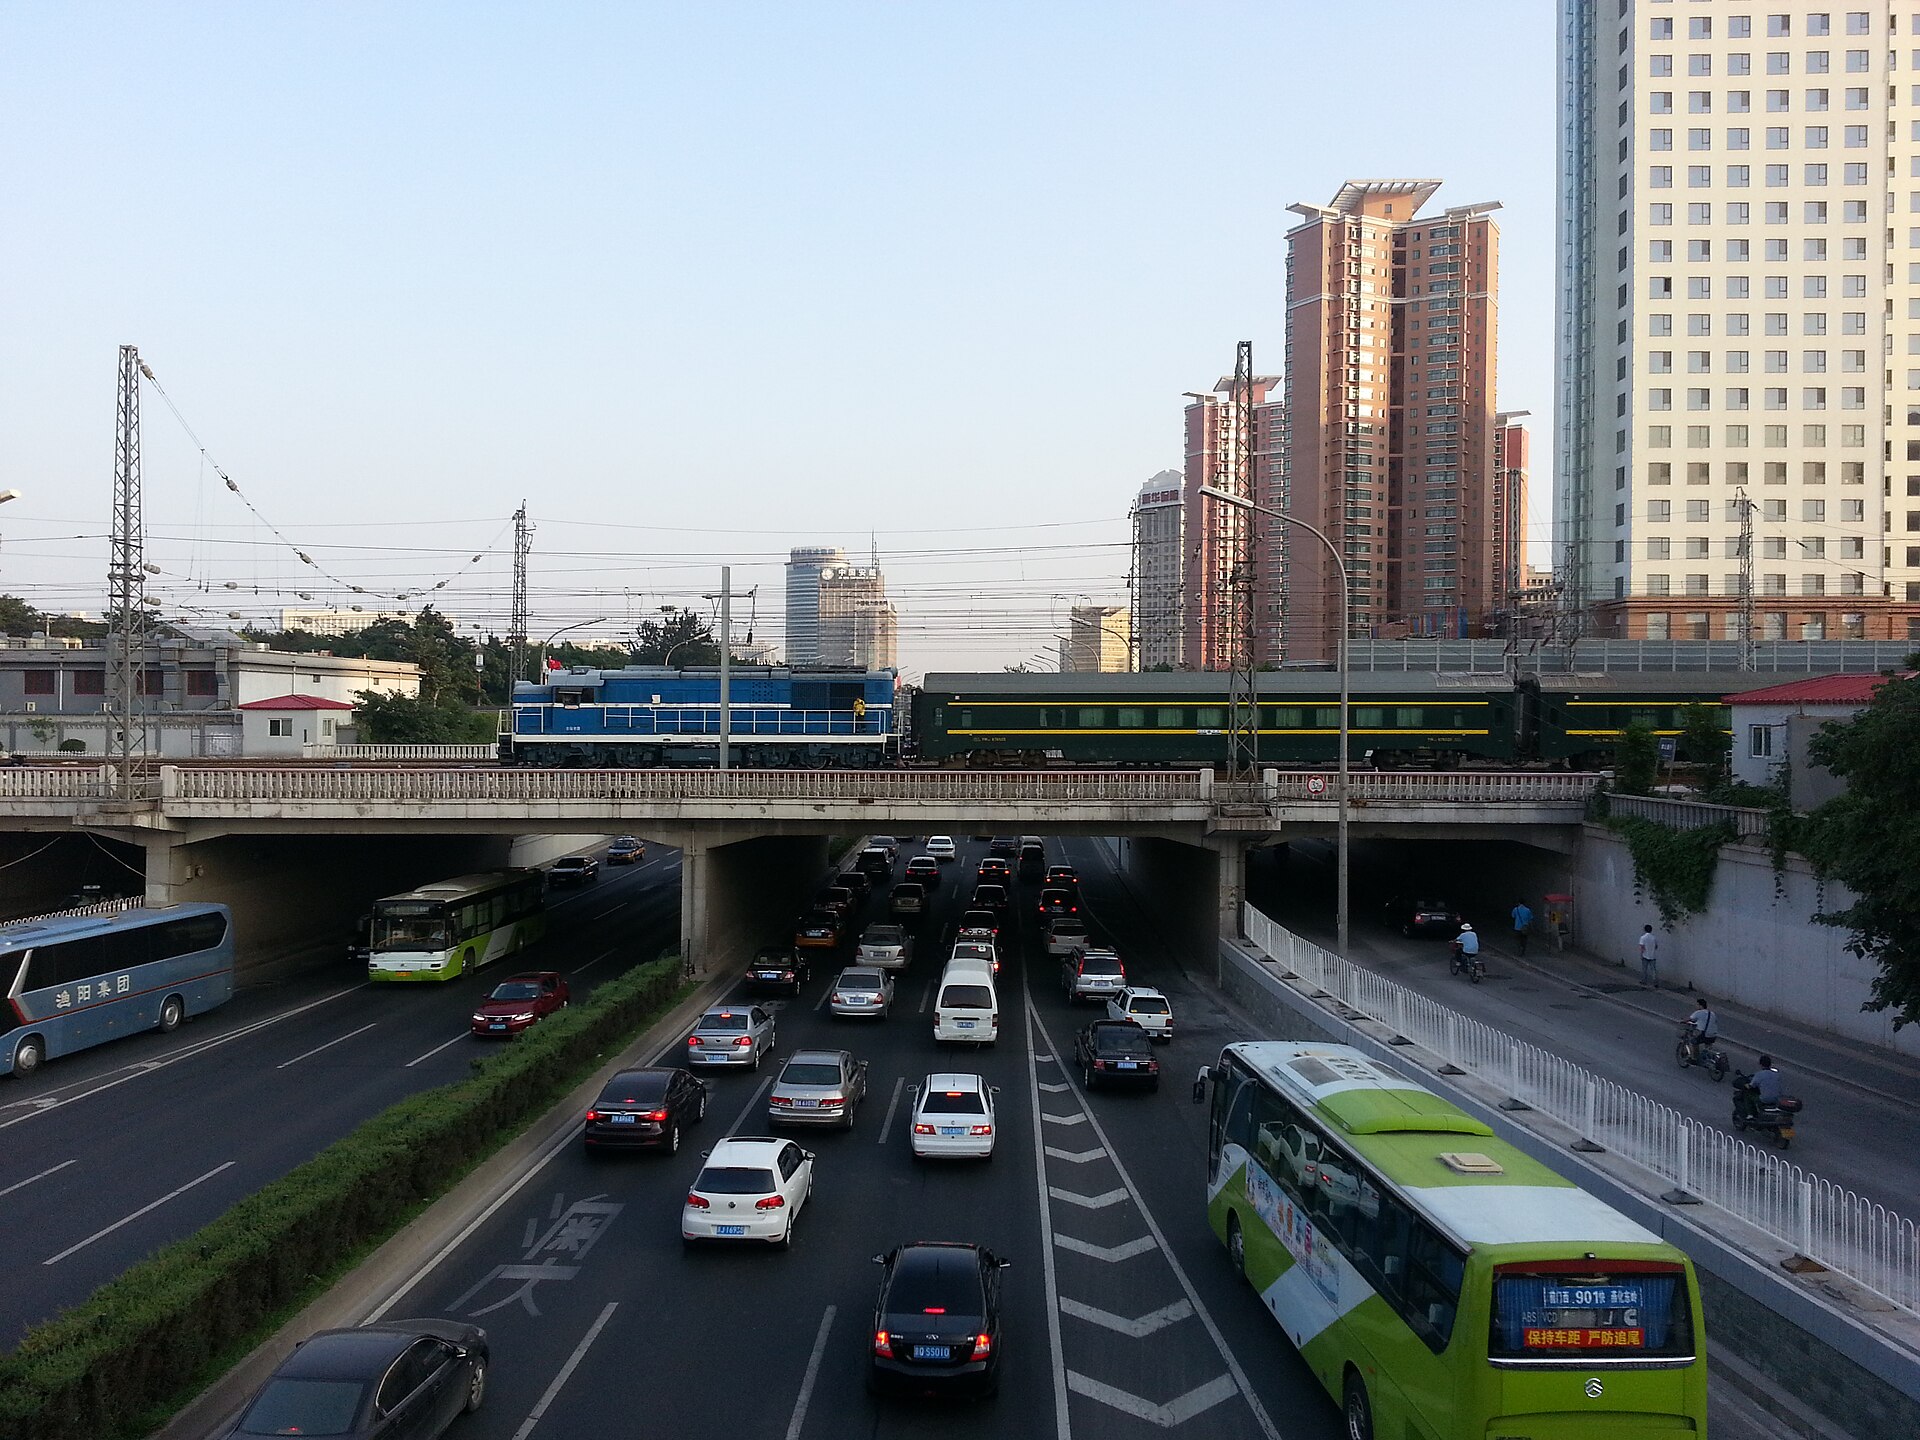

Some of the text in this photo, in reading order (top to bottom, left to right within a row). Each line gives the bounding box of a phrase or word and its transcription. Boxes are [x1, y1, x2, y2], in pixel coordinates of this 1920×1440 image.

[55, 974, 130, 1009] 渔阳集团
[1522, 1311, 1537, 1323] ABS
[1528, 1330, 1641, 1346] 保持车距 严防追尾
